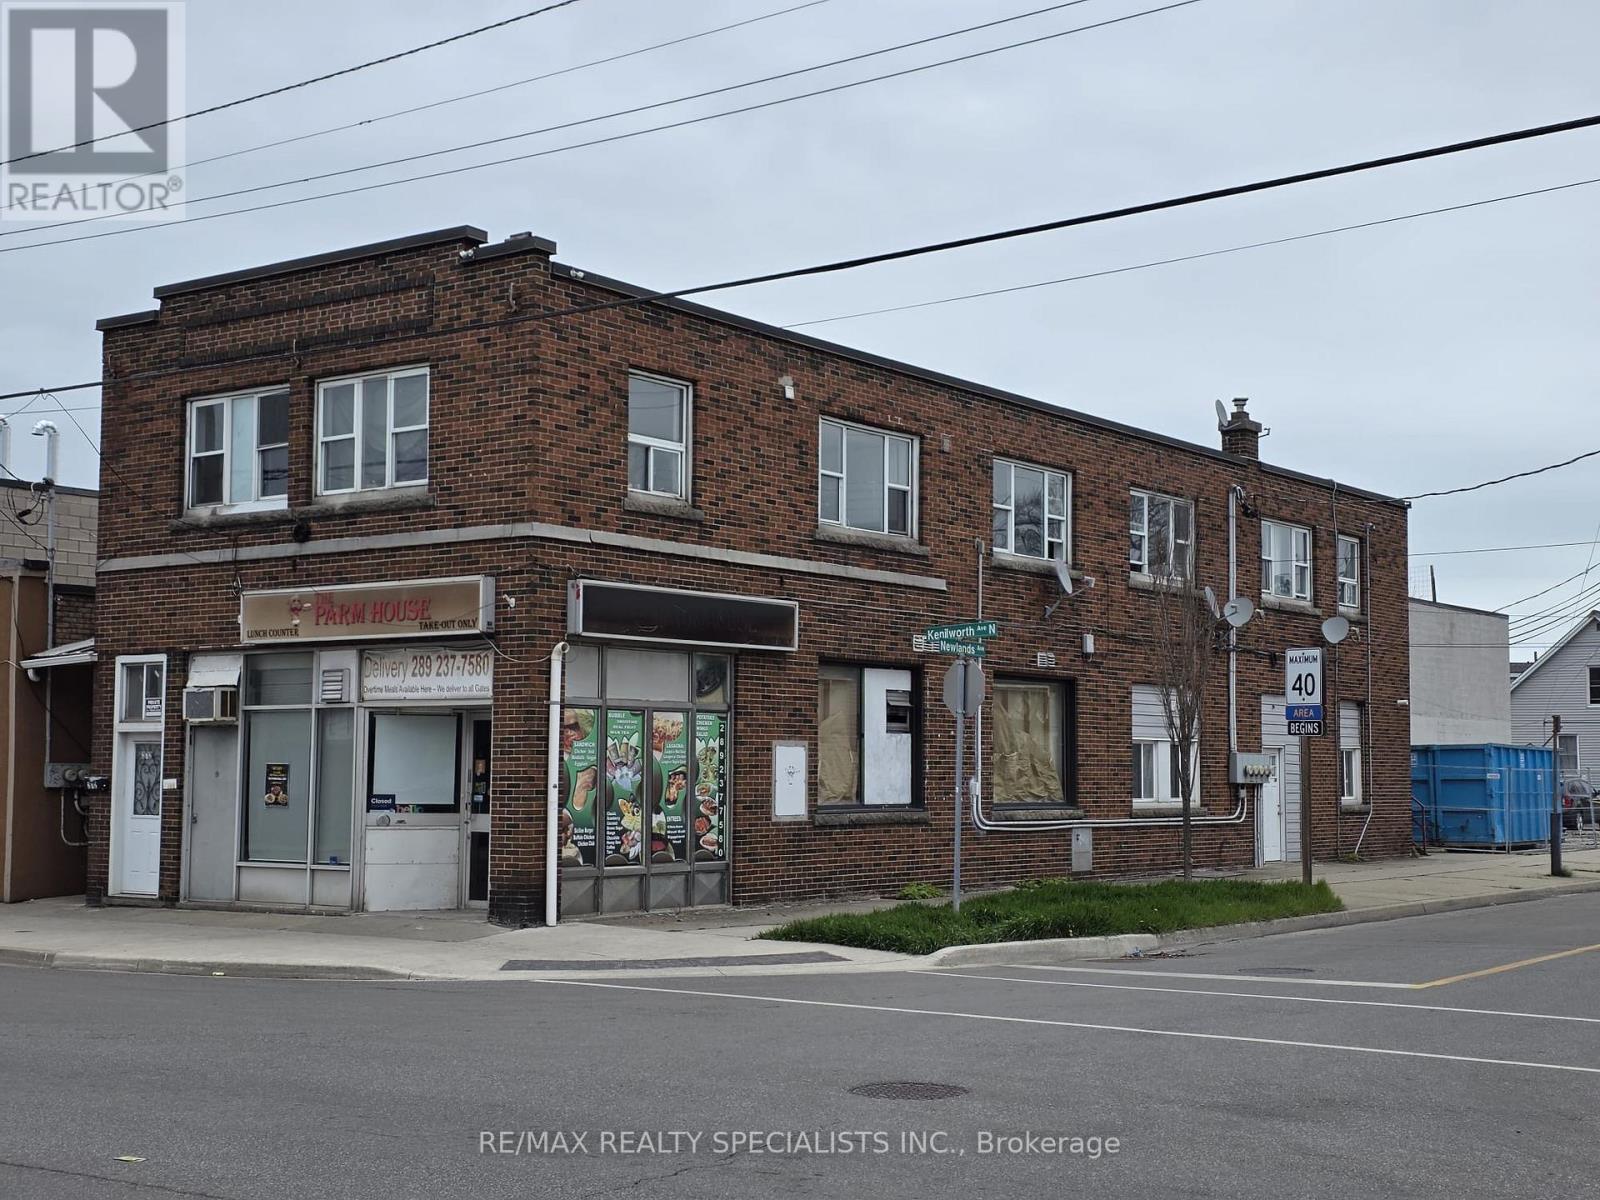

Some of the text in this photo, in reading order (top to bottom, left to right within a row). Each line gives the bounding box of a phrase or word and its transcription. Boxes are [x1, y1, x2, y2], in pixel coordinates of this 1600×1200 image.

[315, 596, 432, 625] PARM HOUSE
[418, 620, 456, 630] TAKE-OUT
[457, 617, 478, 628] ONLY
[247, 628, 300, 638] LUNCH COUNTER
[927, 626, 975, 640] Kenilworth
[988, 623, 996, 634] N
[940, 641, 976, 654] Newlands
[1289, 655, 1318, 664] MAXIMUM
[364, 654, 490, 683] Delivery 289 237-7580
[1292, 673, 1316, 697] 40
[1293, 708, 1315, 718] AREA
[1290, 723, 1319, 734] BEGINS
